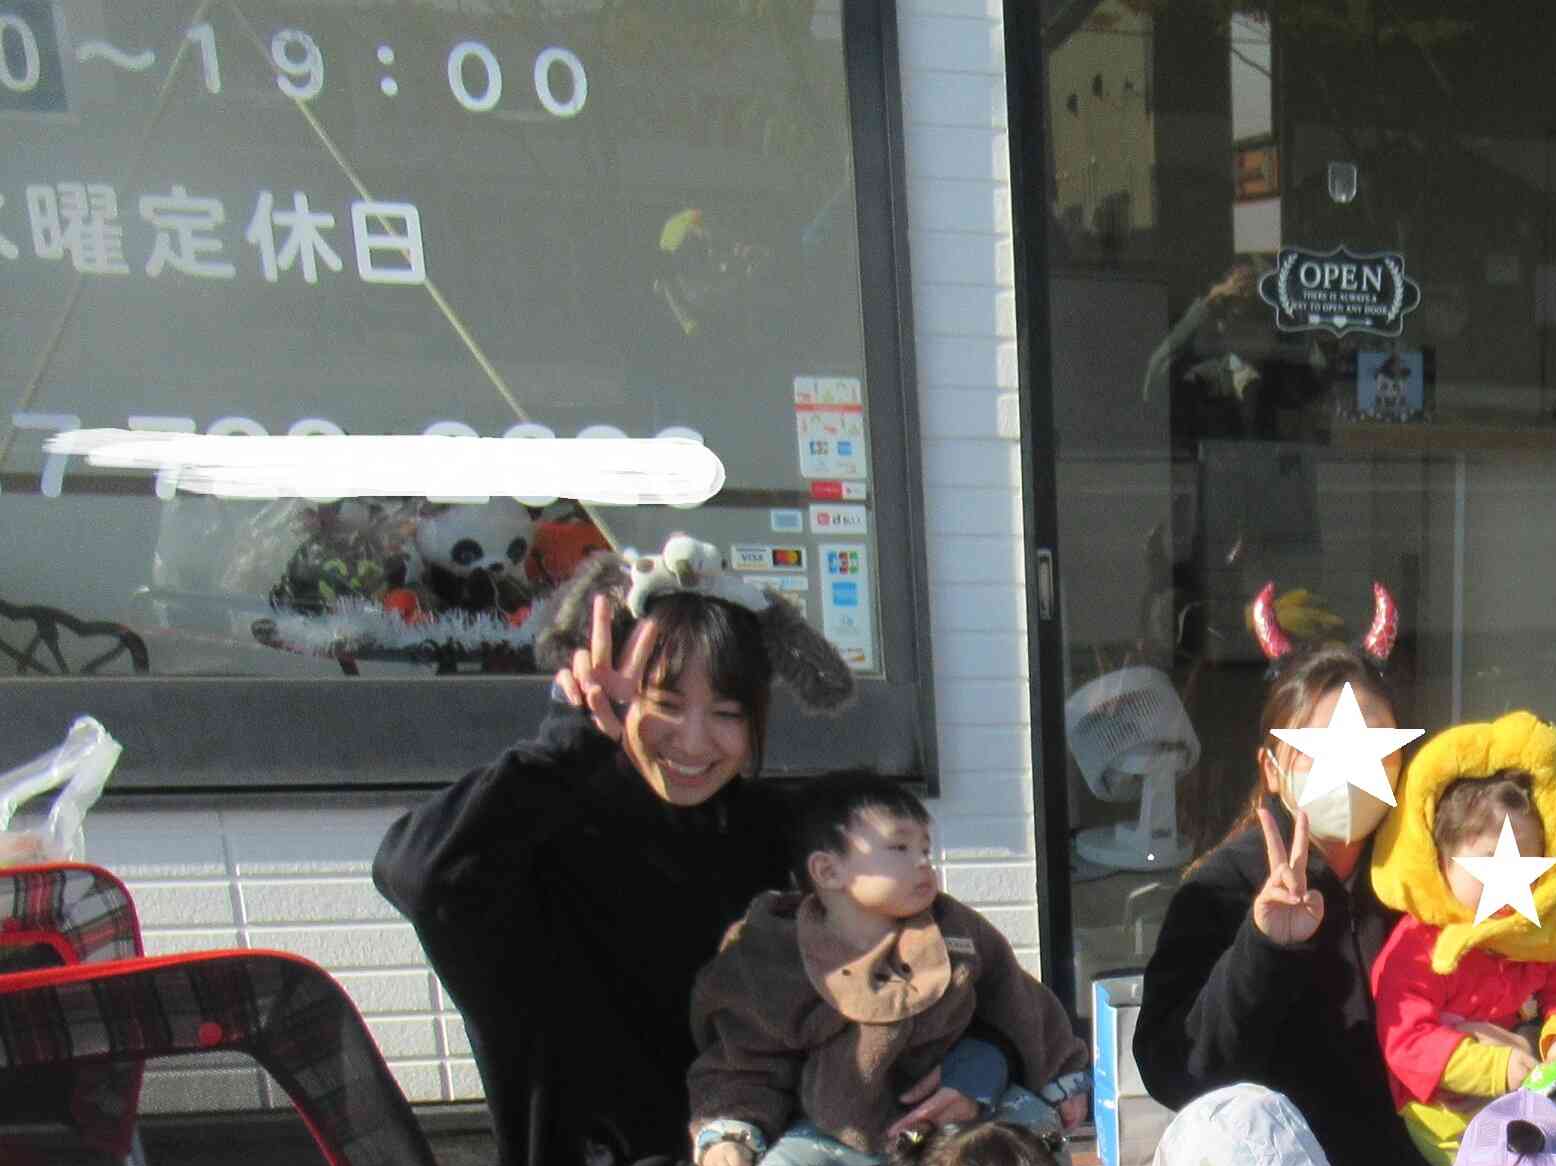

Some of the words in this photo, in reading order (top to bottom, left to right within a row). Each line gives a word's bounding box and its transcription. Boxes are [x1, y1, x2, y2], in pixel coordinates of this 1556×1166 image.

[0, 180, 427, 284] 曜定休日
[1300, 262, 1383, 292] OPEN
